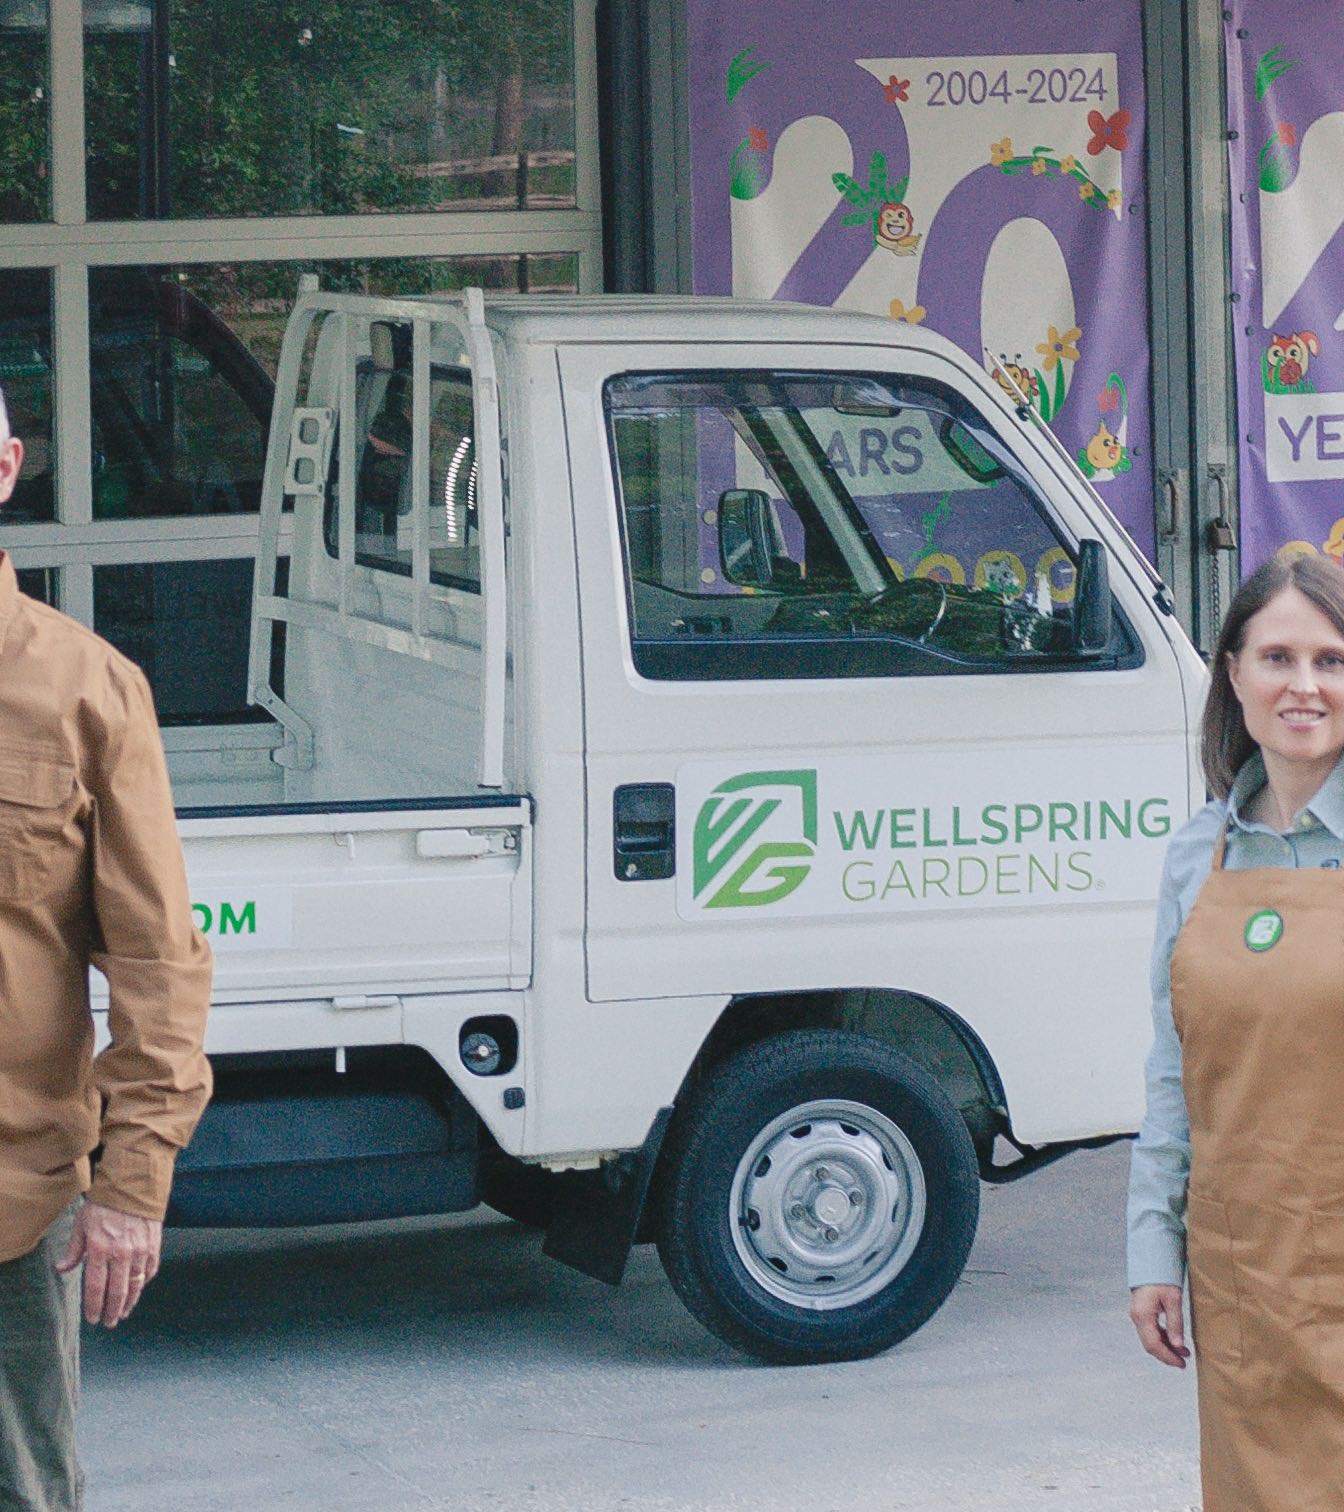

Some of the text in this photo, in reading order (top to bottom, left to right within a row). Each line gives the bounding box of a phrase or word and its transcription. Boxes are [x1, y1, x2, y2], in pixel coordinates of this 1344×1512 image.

[925, 68, 1108, 107] 2004-2024
[826, 425, 924, 477] ARS
[832, 798, 1172, 851] WELLSPRING
